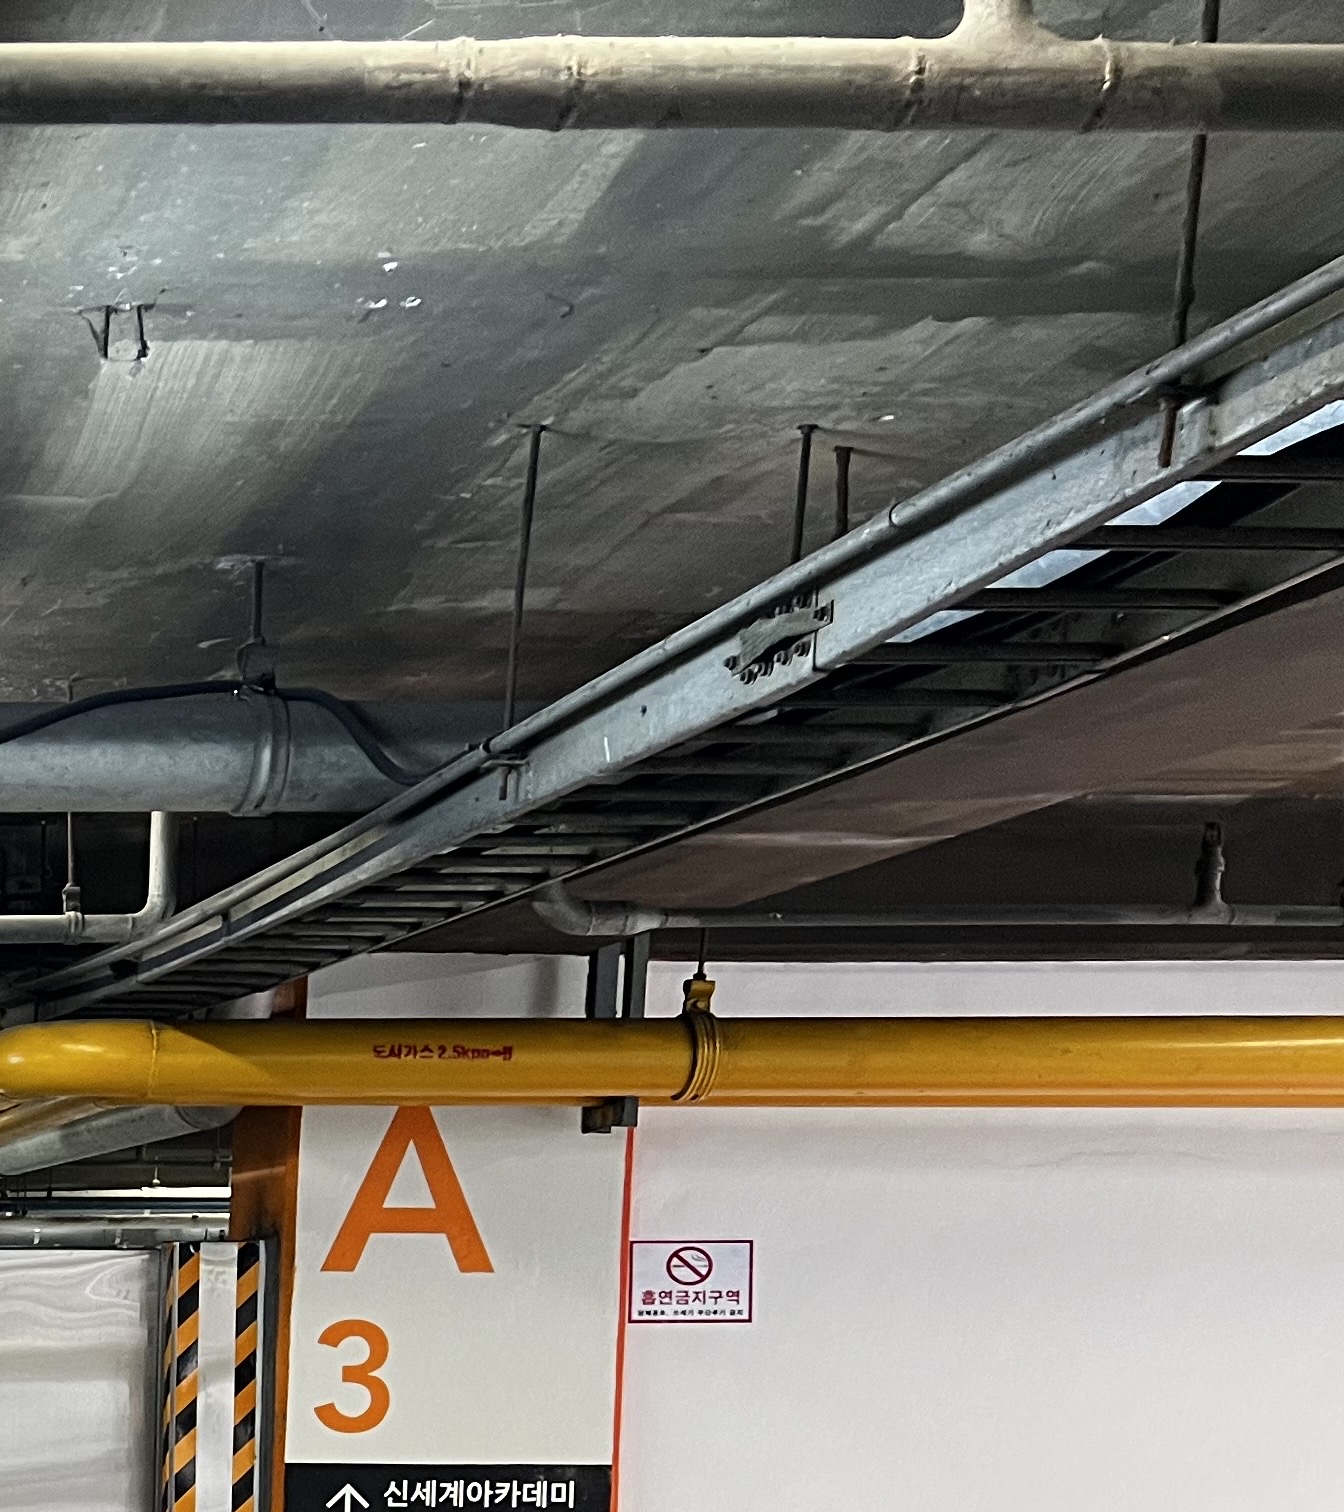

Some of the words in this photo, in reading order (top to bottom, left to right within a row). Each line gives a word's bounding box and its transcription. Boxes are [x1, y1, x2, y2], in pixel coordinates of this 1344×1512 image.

[320, 1105, 495, 1274] A
[641, 1289, 741, 1306] 흡연금지구역
[313, 1319, 391, 1434] 3
[383, 1479, 576, 1509] 신세계아카데미
